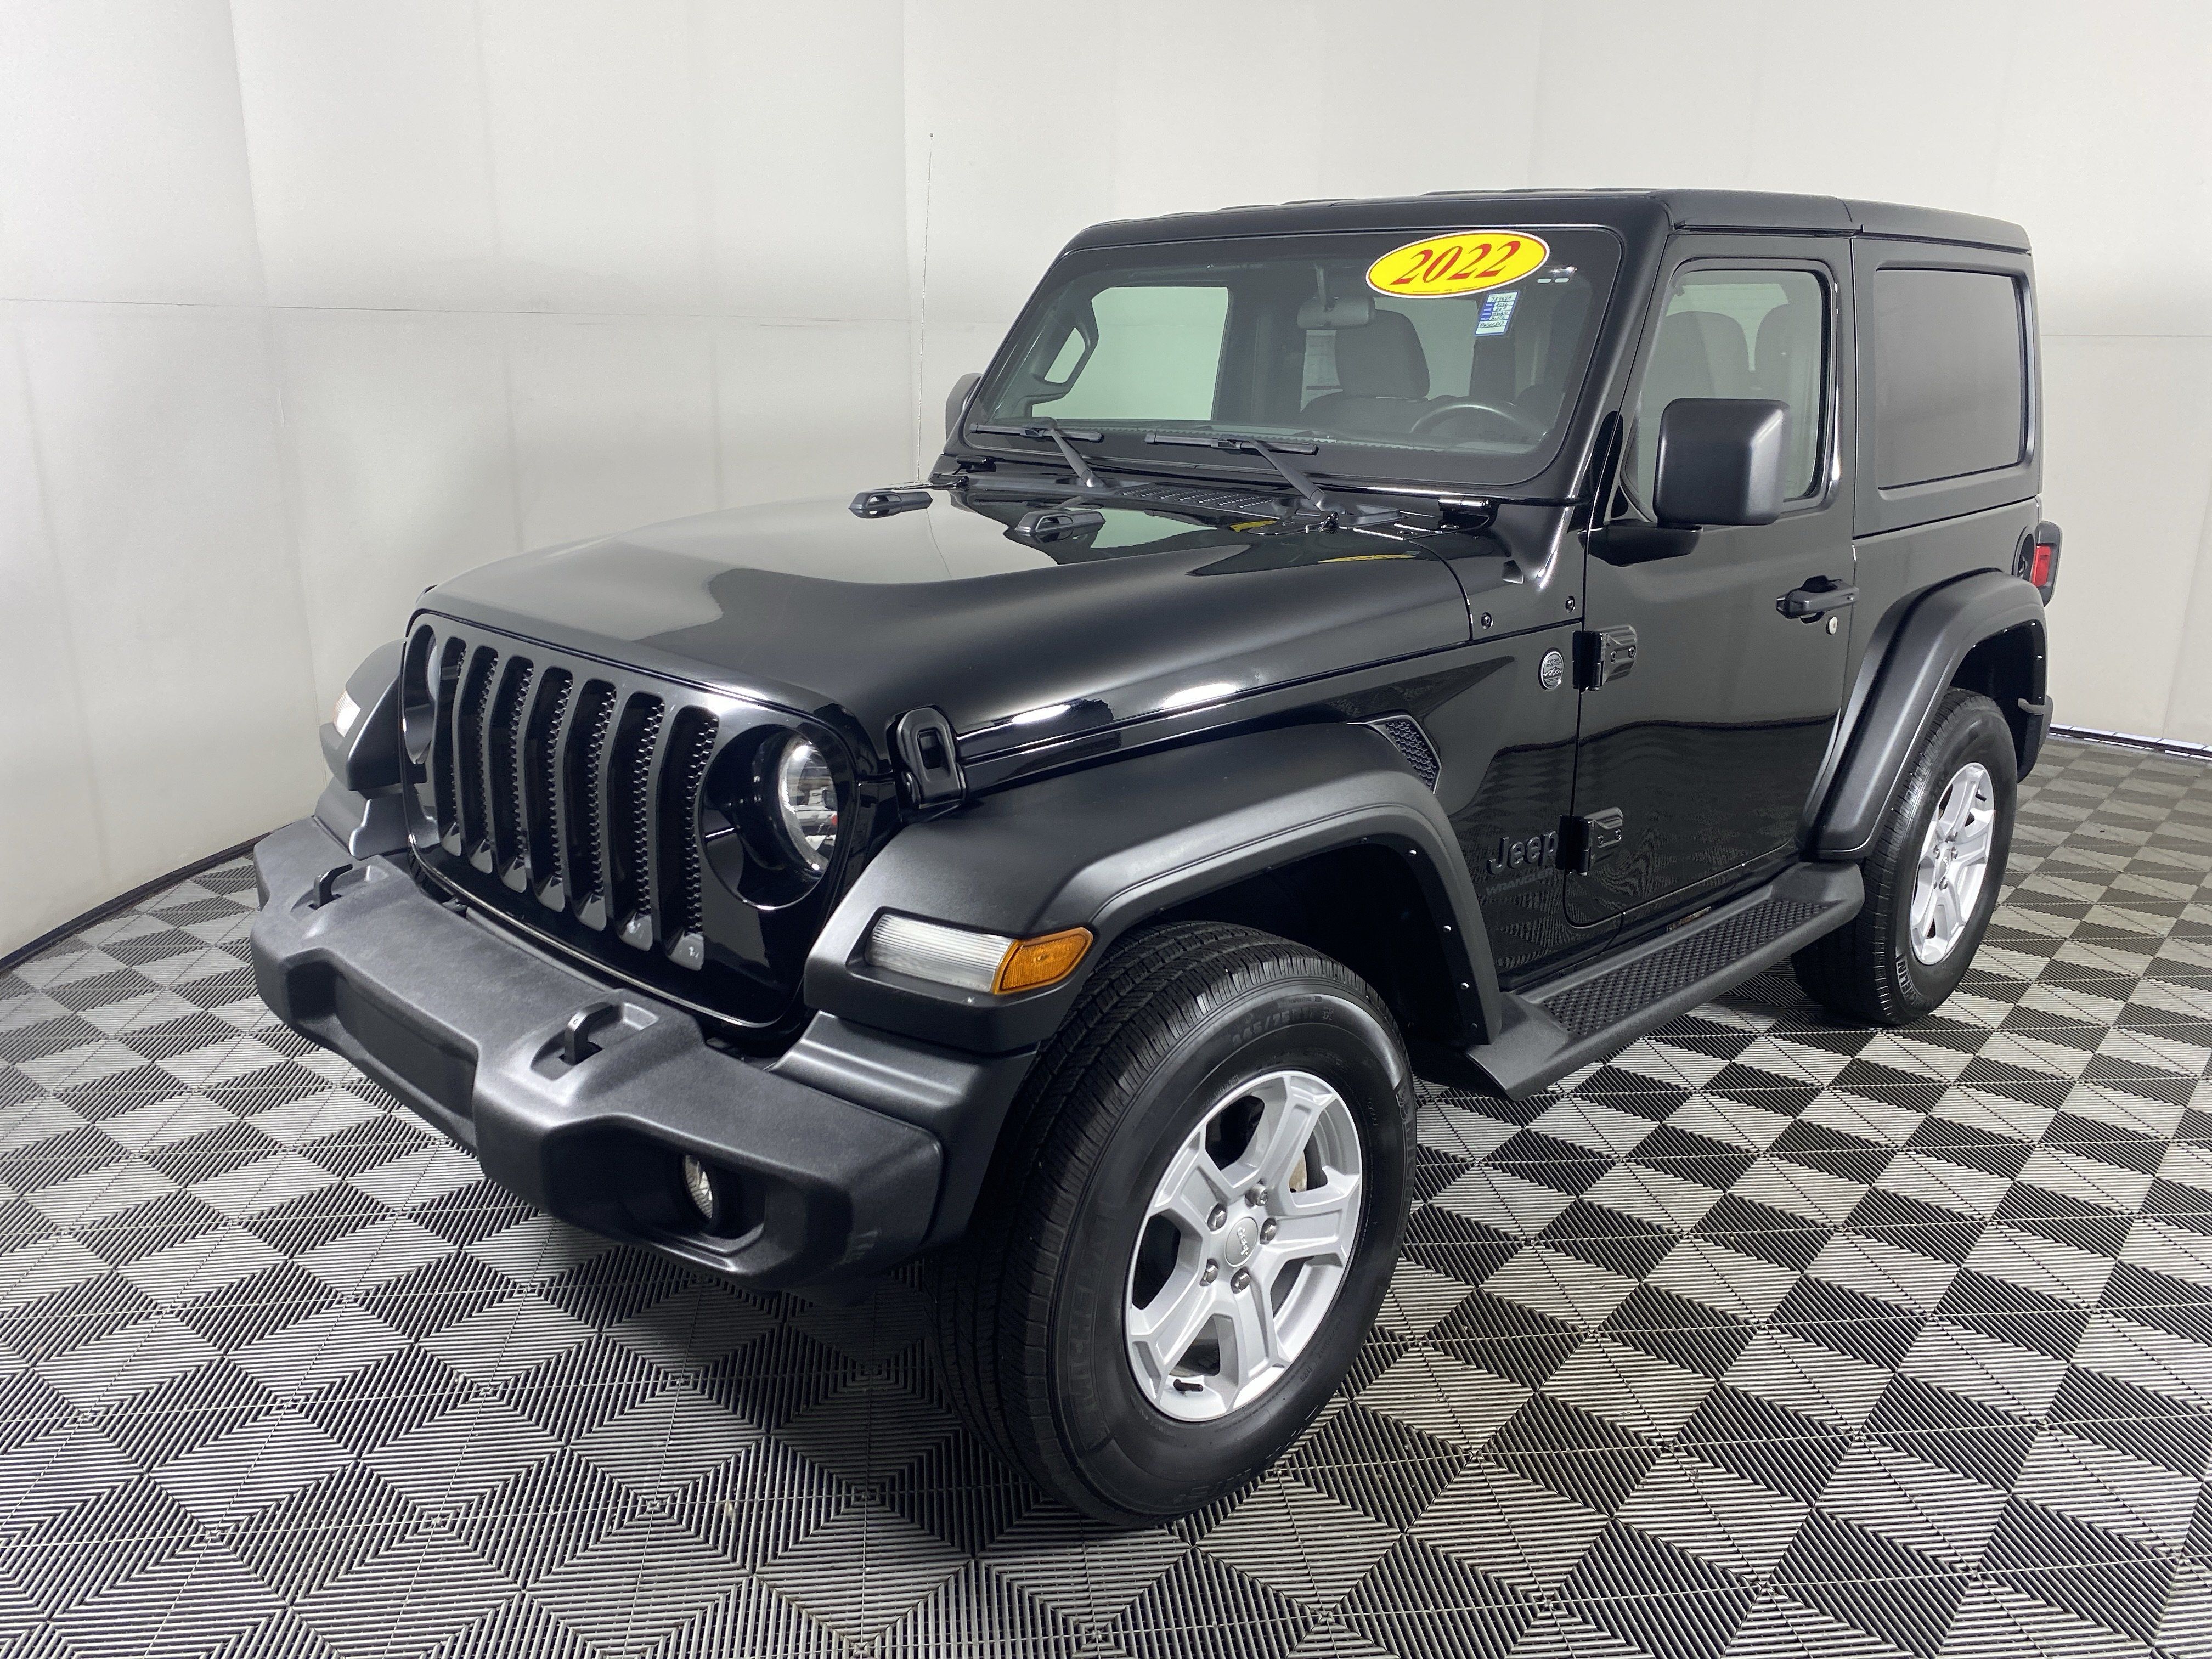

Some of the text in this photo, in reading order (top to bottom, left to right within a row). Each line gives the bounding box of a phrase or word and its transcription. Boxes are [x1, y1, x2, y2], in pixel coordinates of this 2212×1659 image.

[1389, 240, 1521, 286] 2022
[1486, 831, 1559, 875] Jeep
[1486, 868, 1554, 896] WRANGLER
